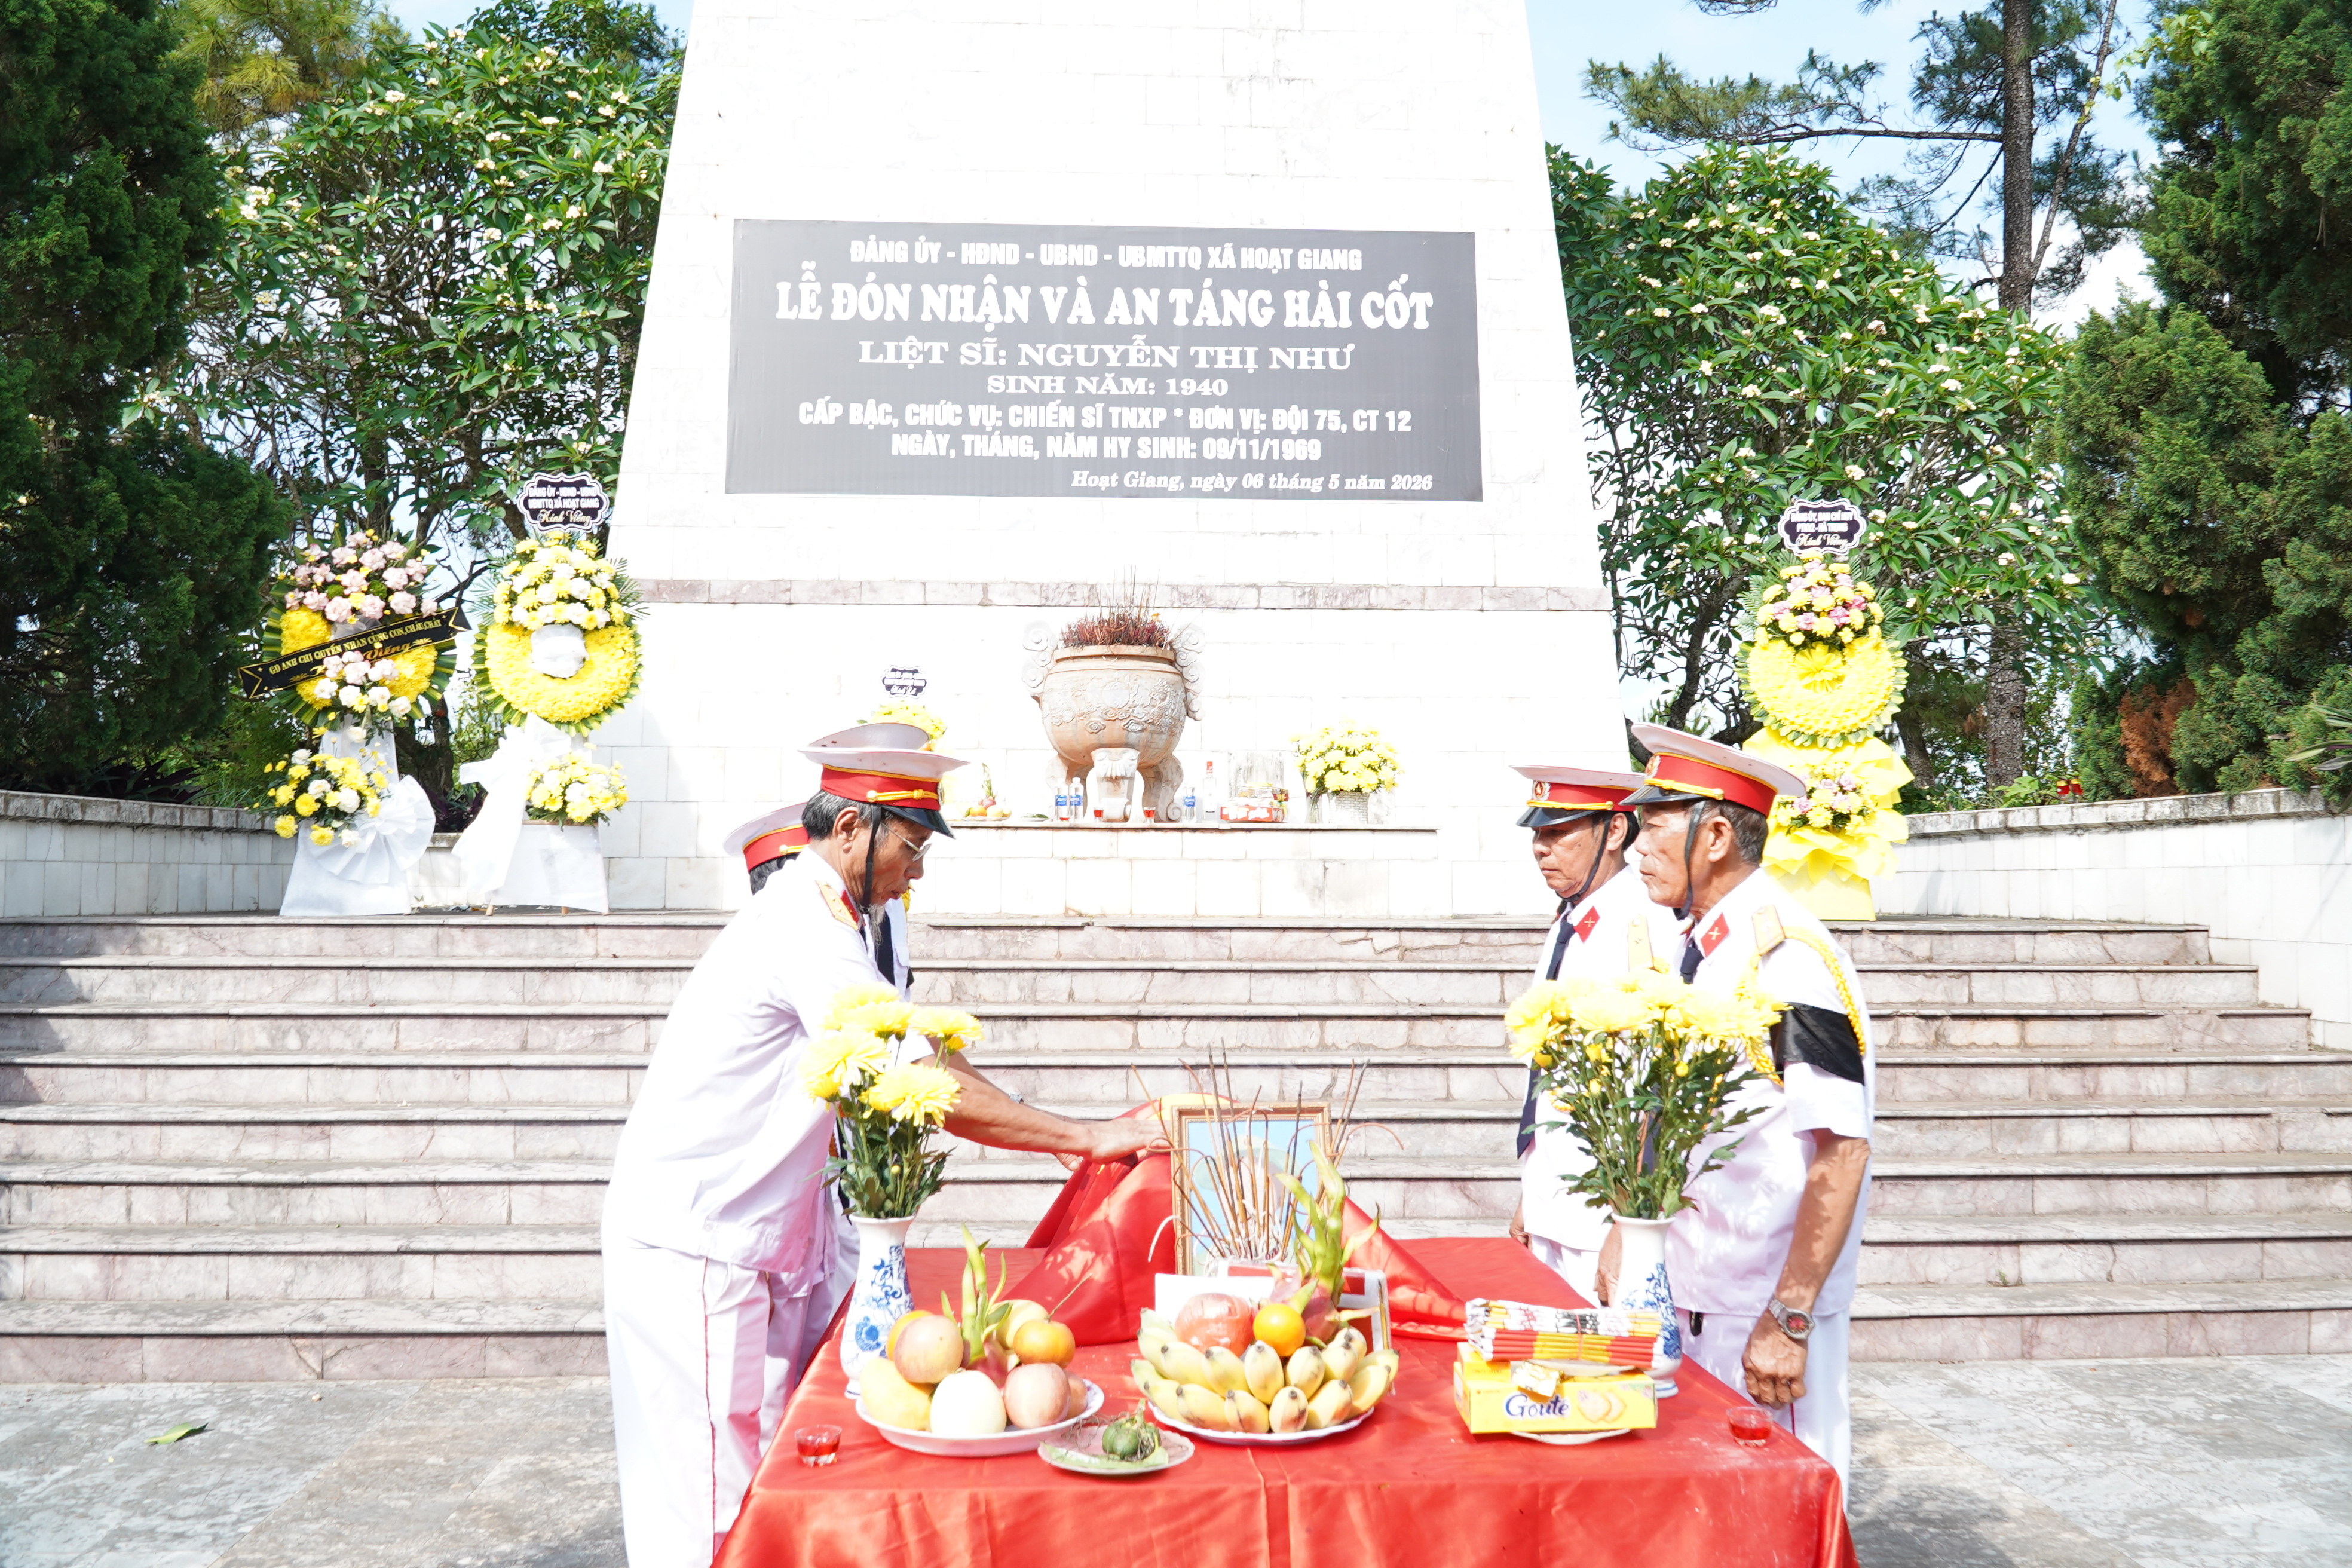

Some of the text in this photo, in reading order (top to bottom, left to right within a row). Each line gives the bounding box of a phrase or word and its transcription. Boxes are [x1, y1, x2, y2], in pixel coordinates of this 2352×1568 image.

[849, 234, 909, 263] ĐẢNG
[914, 235, 942, 264] ỦY
[961, 242, 1020, 265] HĐND
[1040, 244, 1098, 267] UBND
[1118, 245, 1202, 271] UBMTTQ
[1207, 241, 1236, 269] XÃ
[1241, 247, 1293, 274] HOẠT
[1298, 248, 1362, 271] GIANG
[775, 260, 822, 320] LỄ
[830, 272, 912, 321] ĐÓN
[920, 273, 1031, 332] NHẬN
[1039, 275, 1096, 325] VÀ
[1104, 287, 1160, 326] AN
[1168, 277, 1275, 327] TÁNG
[1360, 274, 1434, 329] CỐT
[858, 334, 1355, 374] LIỆT SĨ: NGUYỄN THỊ NHƯ
[987, 372, 1229, 396] SINH NĂM: 1940
[798, 396, 1411, 435] CẤP BẬC, CHỨC VỤ: CHIẾN SĨ TNXP ĐƠN VỊ: ĐỘI 75, CT 12
[892, 429, 1321, 461] NGÀY, THÁNG, NĂM HY SINH: 09/11/1969
[1071, 470, 1433, 493] Hoạt Giang, ngày 06 tháng 5 năm 2026
[281, 657, 298, 670] ANH
